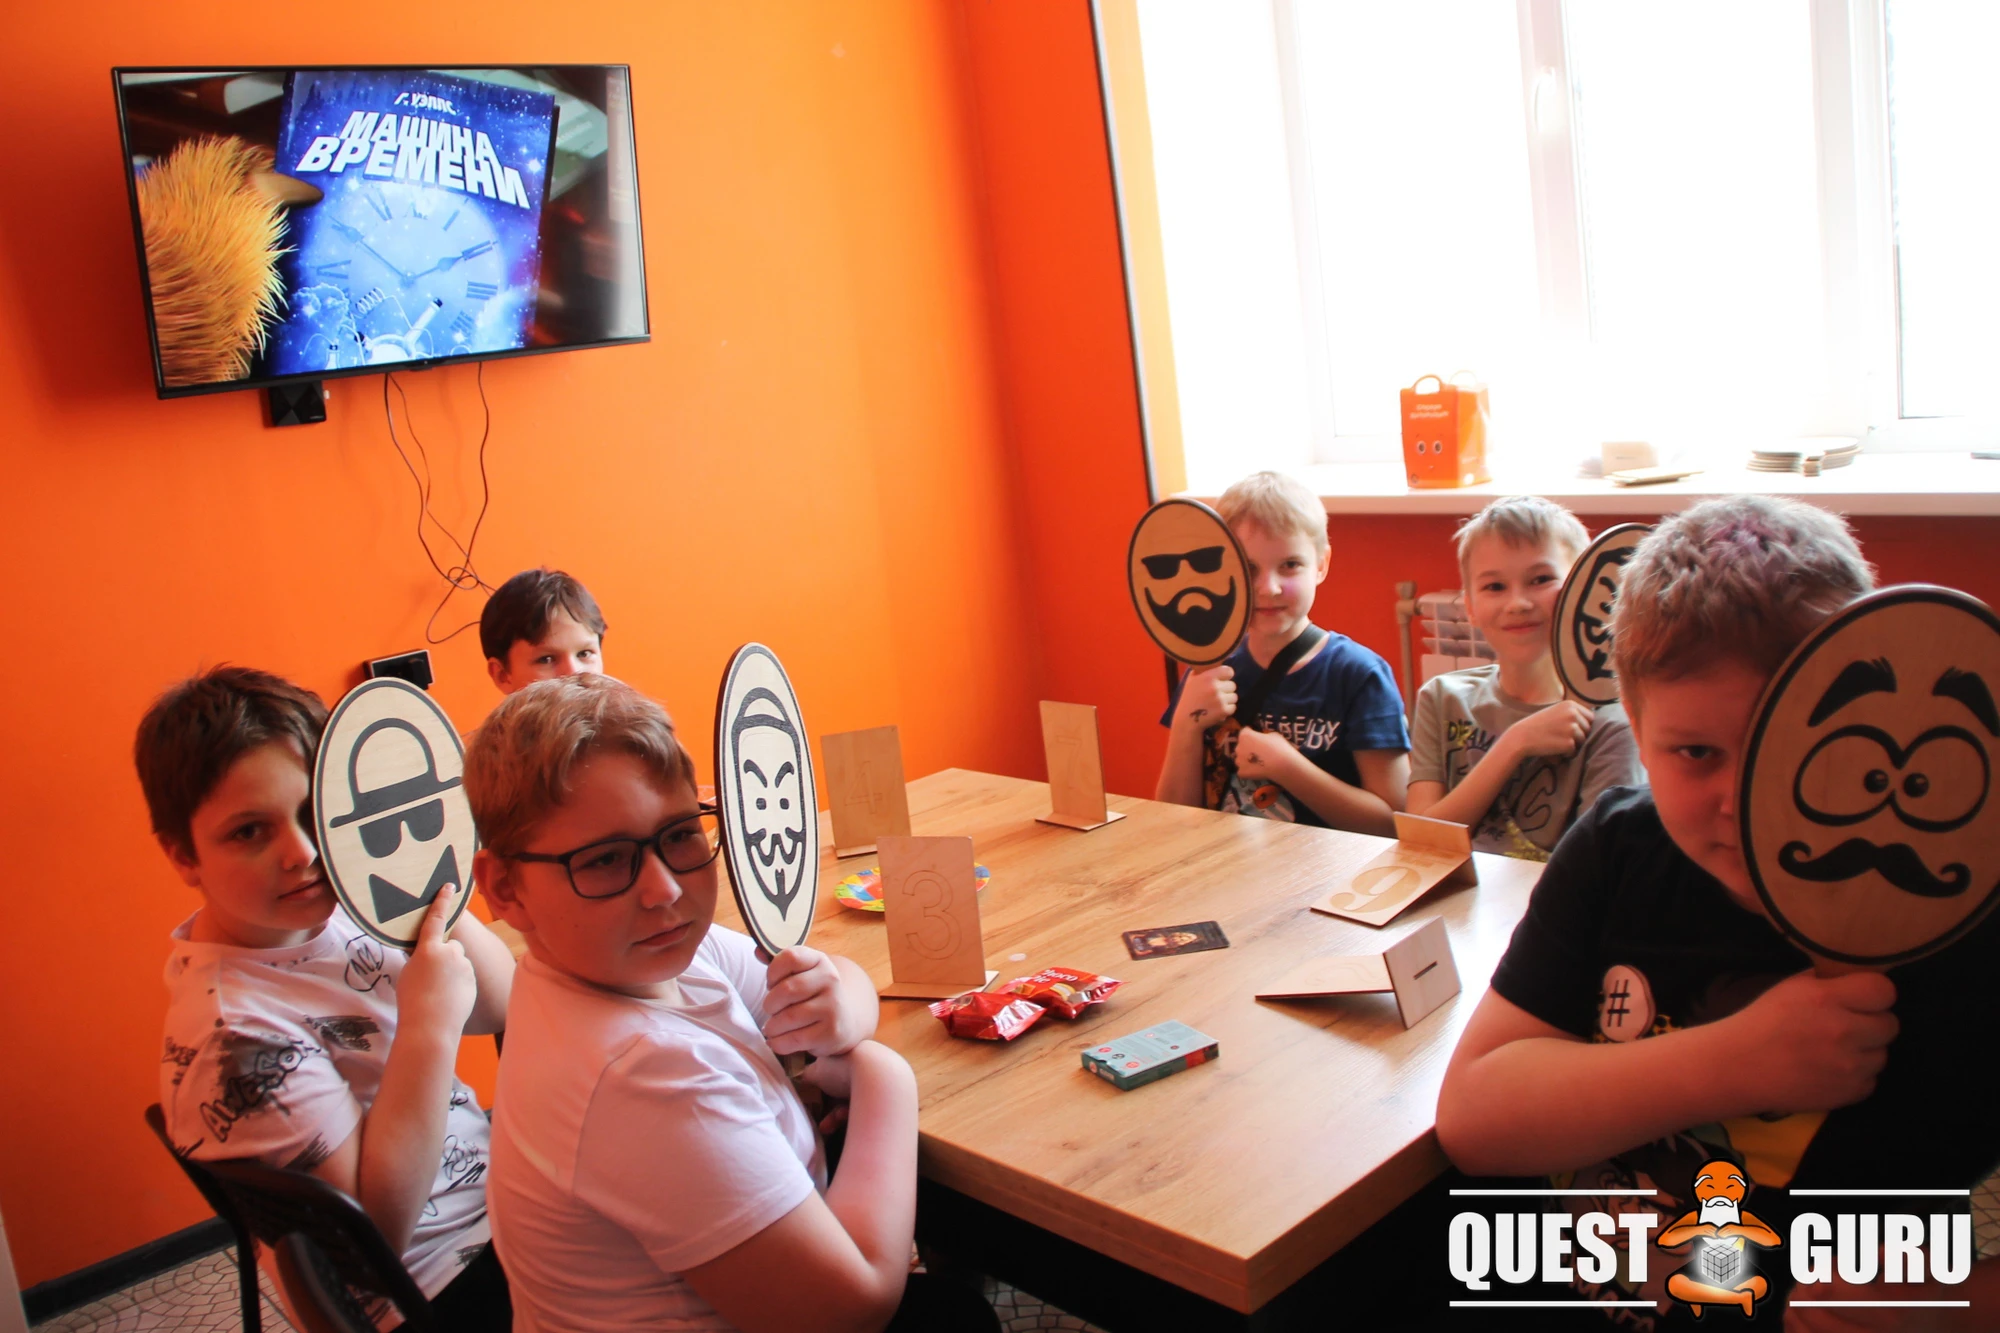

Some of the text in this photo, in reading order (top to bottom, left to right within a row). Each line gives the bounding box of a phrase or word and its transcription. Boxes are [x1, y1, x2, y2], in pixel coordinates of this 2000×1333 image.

[394, 92, 409, 106] Г.
[340, 111, 497, 164] МАШИНА
[296, 136, 531, 210] ВРЕМЕНИ
[902, 869, 962, 961] 3
